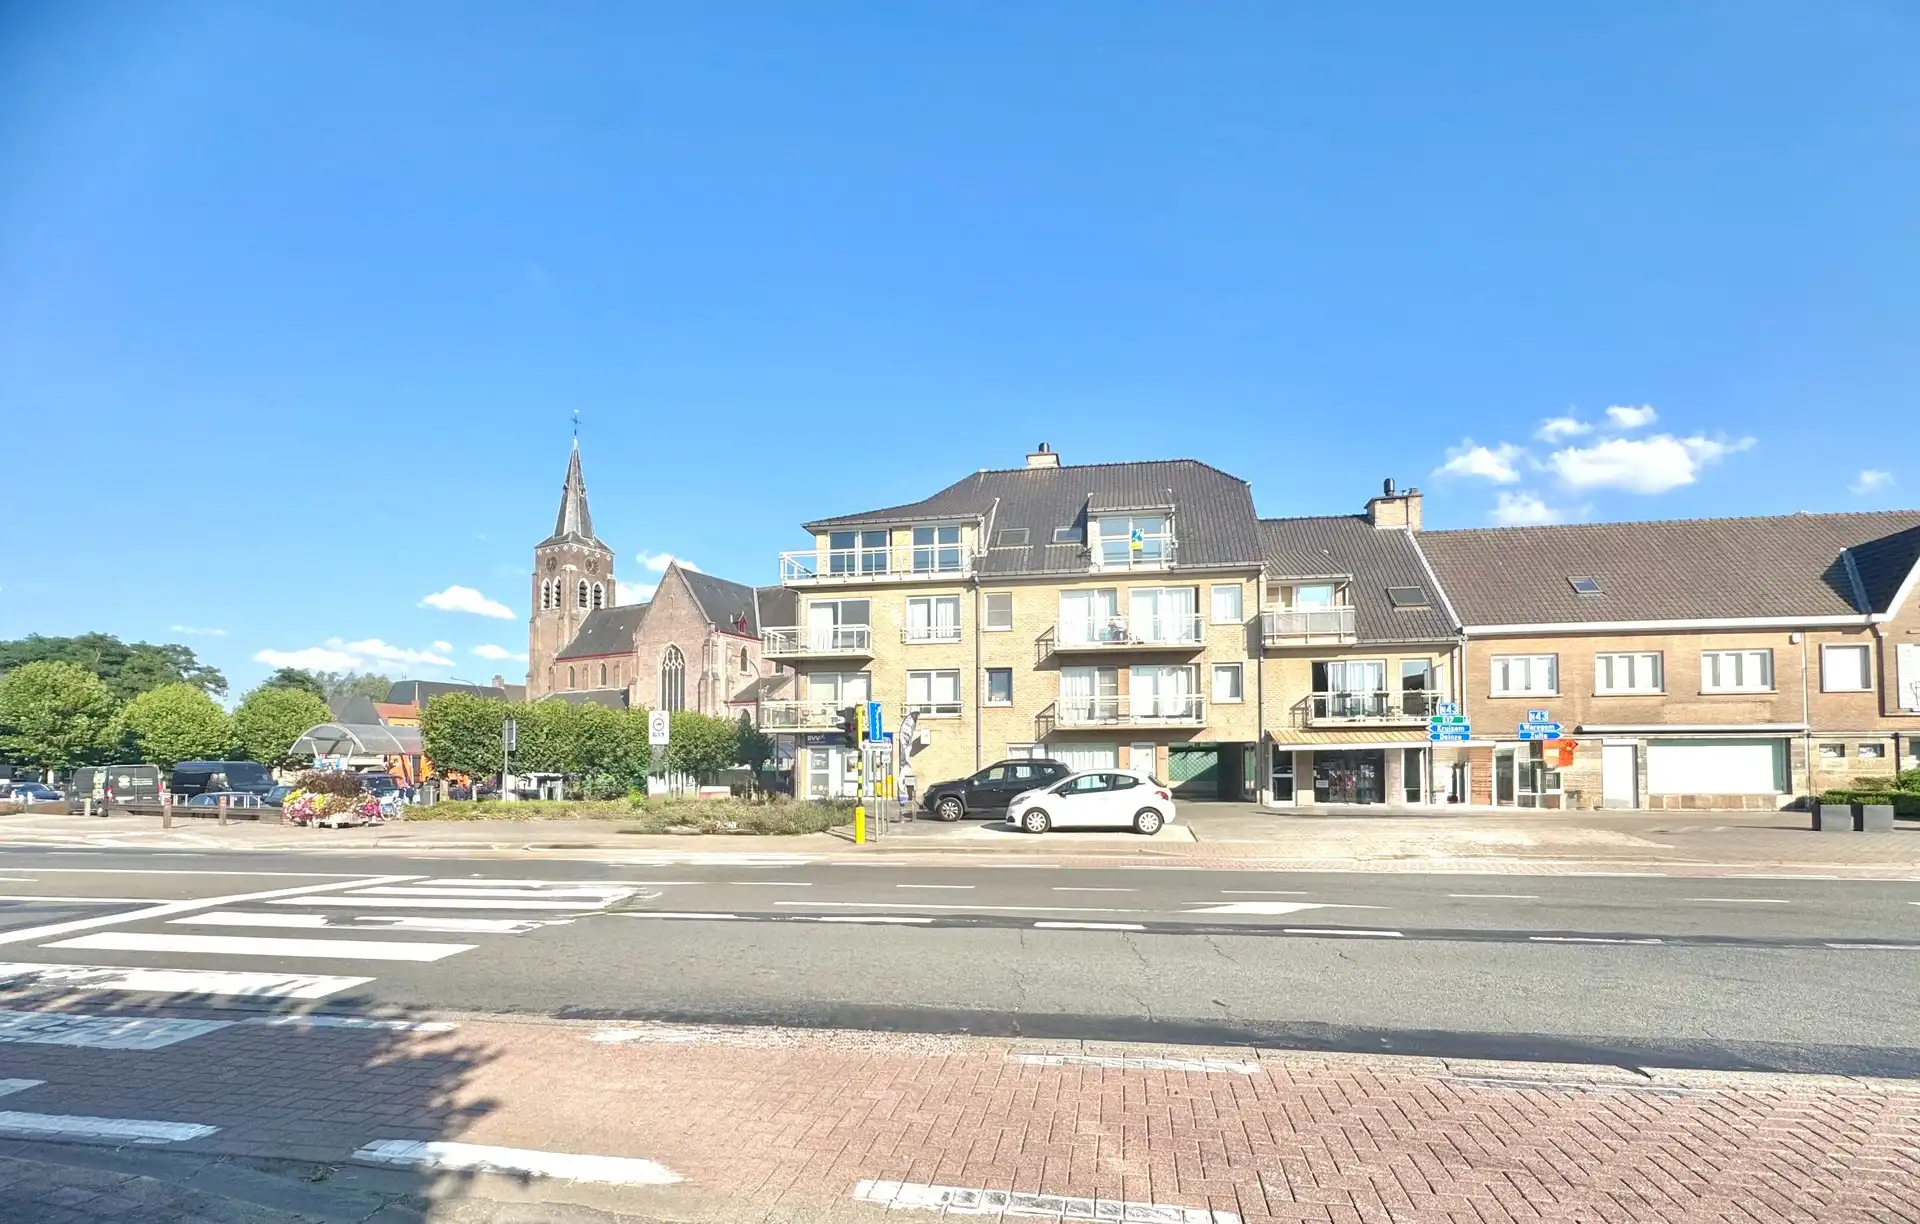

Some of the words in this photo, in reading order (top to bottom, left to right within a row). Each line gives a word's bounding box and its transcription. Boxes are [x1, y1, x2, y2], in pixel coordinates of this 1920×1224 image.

[1529, 711, 1548, 721] N43
[1437, 725, 1465, 733] Kruisem
[1523, 723, 1555, 732] Waregem
